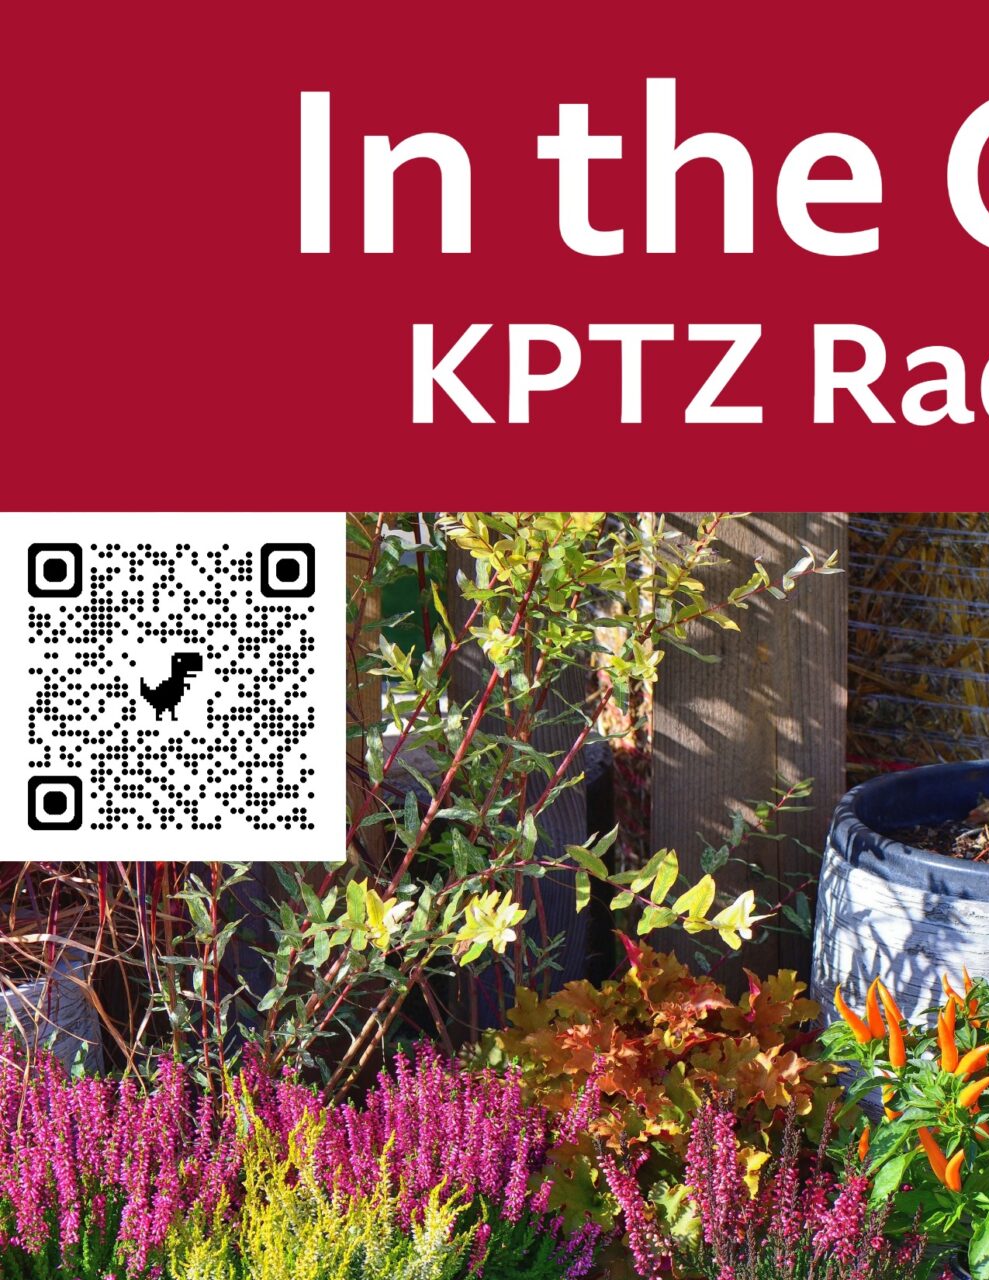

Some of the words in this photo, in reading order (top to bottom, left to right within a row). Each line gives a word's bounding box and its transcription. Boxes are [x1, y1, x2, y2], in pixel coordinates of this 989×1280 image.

[300, 91, 472, 254] In
[537, 77, 883, 257] the
[412, 323, 763, 424] KPTZ
